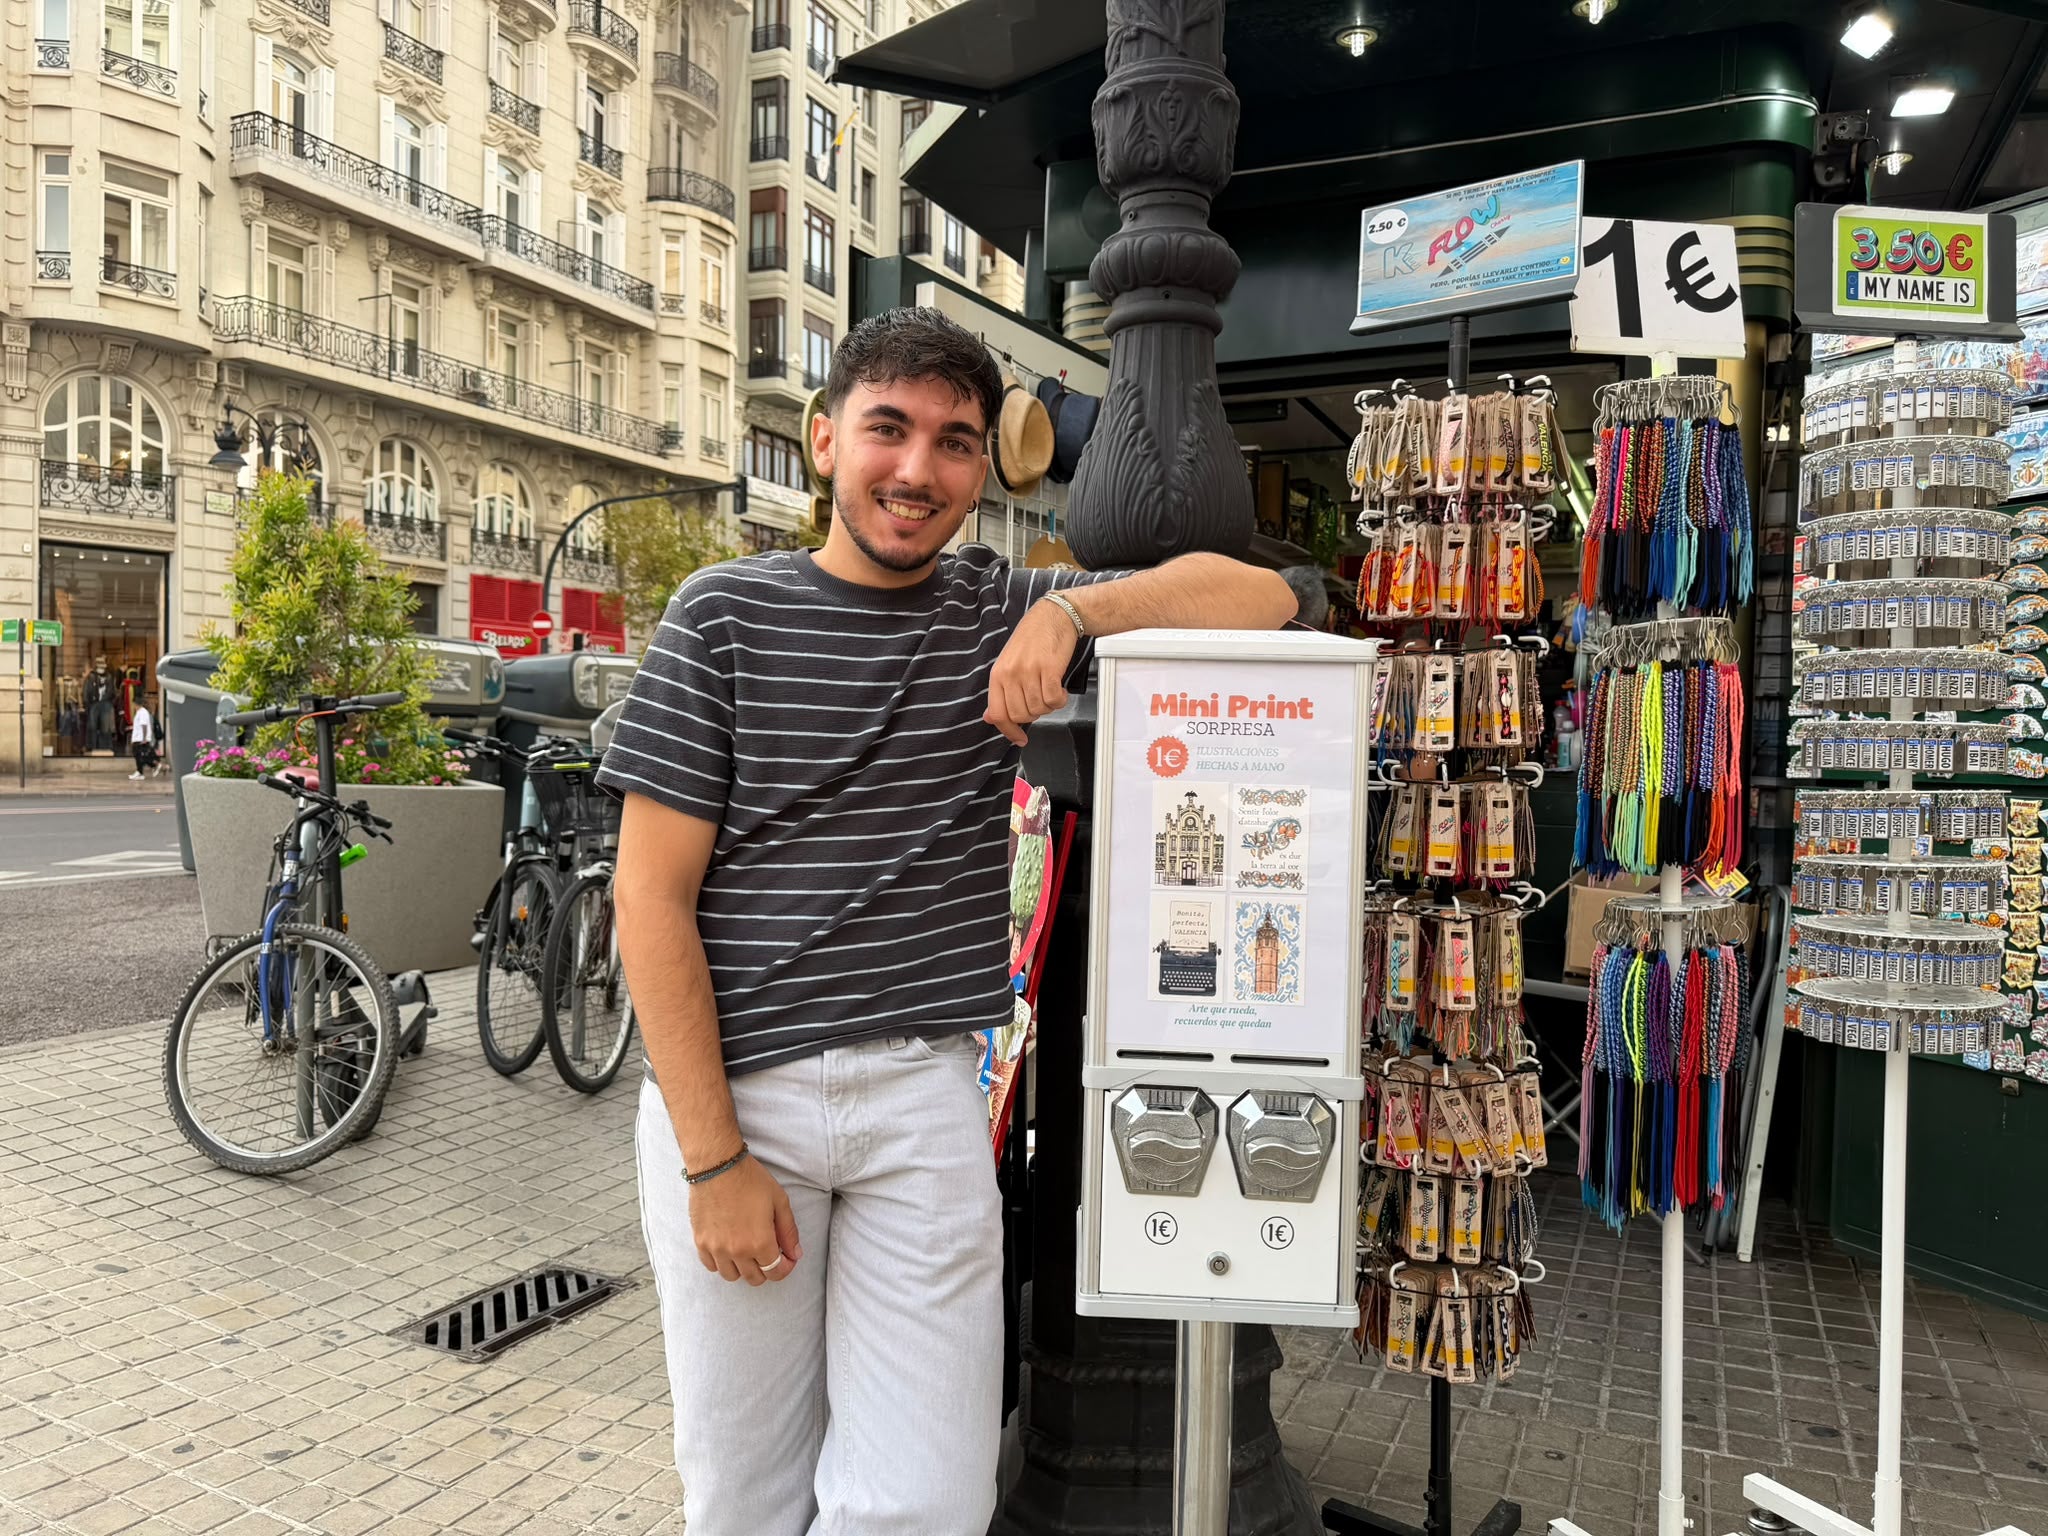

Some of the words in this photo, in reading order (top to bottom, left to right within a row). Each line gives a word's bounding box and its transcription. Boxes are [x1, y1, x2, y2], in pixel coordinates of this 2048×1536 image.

[1368, 220, 1393, 234] 2.50
[1397, 217, 1407, 228] €
[1482, 266, 1519, 279] LLEVARLO
[1583, 219, 1644, 338] 1
[1664, 230, 1739, 314] €
[1865, 276, 1891, 299] MY
[1897, 278, 1945, 302] NAME
[1953, 282, 1971, 304] IS
[1949, 402, 1958, 416] AMO
[1501, 419, 1514, 474] VALENCIA
[1538, 423, 1549, 474] VALENCIA
[1855, 467, 1864, 488] GUAPO
[1845, 538, 1853, 560] ALEXIS
[1859, 536, 1868, 557] ALICE
[1874, 536, 1883, 558] ALICIA
[1889, 534, 1898, 556] ALMA
[1953, 535, 1962, 552] AMY
[1966, 537, 1974, 553] ANA
[1843, 608, 1851, 626] AXEL
[1887, 607, 1896, 622] BEN
[1903, 603, 1911, 625] BENITO
[1805, 678, 1813, 700] ELENA
[1815, 683, 1823, 693] ELI
[1833, 676, 1842, 696] ELISA
[1863, 675, 1872, 695] ELLIE
[1879, 673, 1887, 695] EMILIA
[1893, 673, 1902, 695] EMILIO
[1908, 673, 1917, 695] EMILY
[1923, 673, 1932, 696] EMMA
[1949, 676, 1959, 695] ENZO
[1964, 677, 1973, 694] ERIC
[1150, 692, 1219, 717] Mini
[1227, 693, 1314, 720] Print
[1186, 721, 1275, 737] SORPRESA
[1155, 745, 1182, 768] 1€
[1196, 747, 1279, 758] ILUSTRACIONES
[1823, 744, 1832, 765] GIULIA
[1846, 744, 1856, 766] GRACE
[1894, 744, 1902, 767] HELENA
[1908, 744, 1918, 768] HENRY
[1925, 745, 1934, 768] HOMER
[1941, 746, 1951, 769] HUGO
[1196, 760, 1240, 772] HECHAS
[1241, 762, 1249, 771] A
[1251, 762, 1285, 772] MANO
[1811, 817, 1820, 832] JON
[1833, 814, 1843, 836] JORDAN
[1848, 814, 1857, 837] JORDI
[1862, 814, 1871, 837] JORGE
[1876, 816, 1886, 834] JOSE
[1907, 814, 1916, 836] JOSHUA
[1953, 815, 1963, 836] JULIA
[1966, 814, 1974, 837] JULIAN
[1992, 814, 2000, 835] KATIE
[1821, 883, 1830, 904] MARK
[1878, 886, 1888, 908] MARY
[1943, 890, 1952, 908] MAX
[1956, 887, 1964, 910] MEGAN
[1173, 928, 1208, 937] VALENCIA
[1817, 948, 1826, 970] PAULA
[1841, 950, 1850, 975] PETER
[1188, 1003, 1209, 1014] Arte
[1209, 1006, 1227, 1016] que
[1228, 1005, 1258, 1016] rueda,
[1174, 1016, 1218, 1027] recuerdos
[1219, 1018, 1238, 1028] que
[1238, 1019, 1272, 1030] quedan
[1847, 1024, 1856, 1044] VEGA
[1927, 1030, 1936, 1052] WALTER
[1967, 1029, 1977, 1052] YVETTE
[1152, 1218, 1171, 1238] 1€
[1268, 1223, 1288, 1243] 1€
